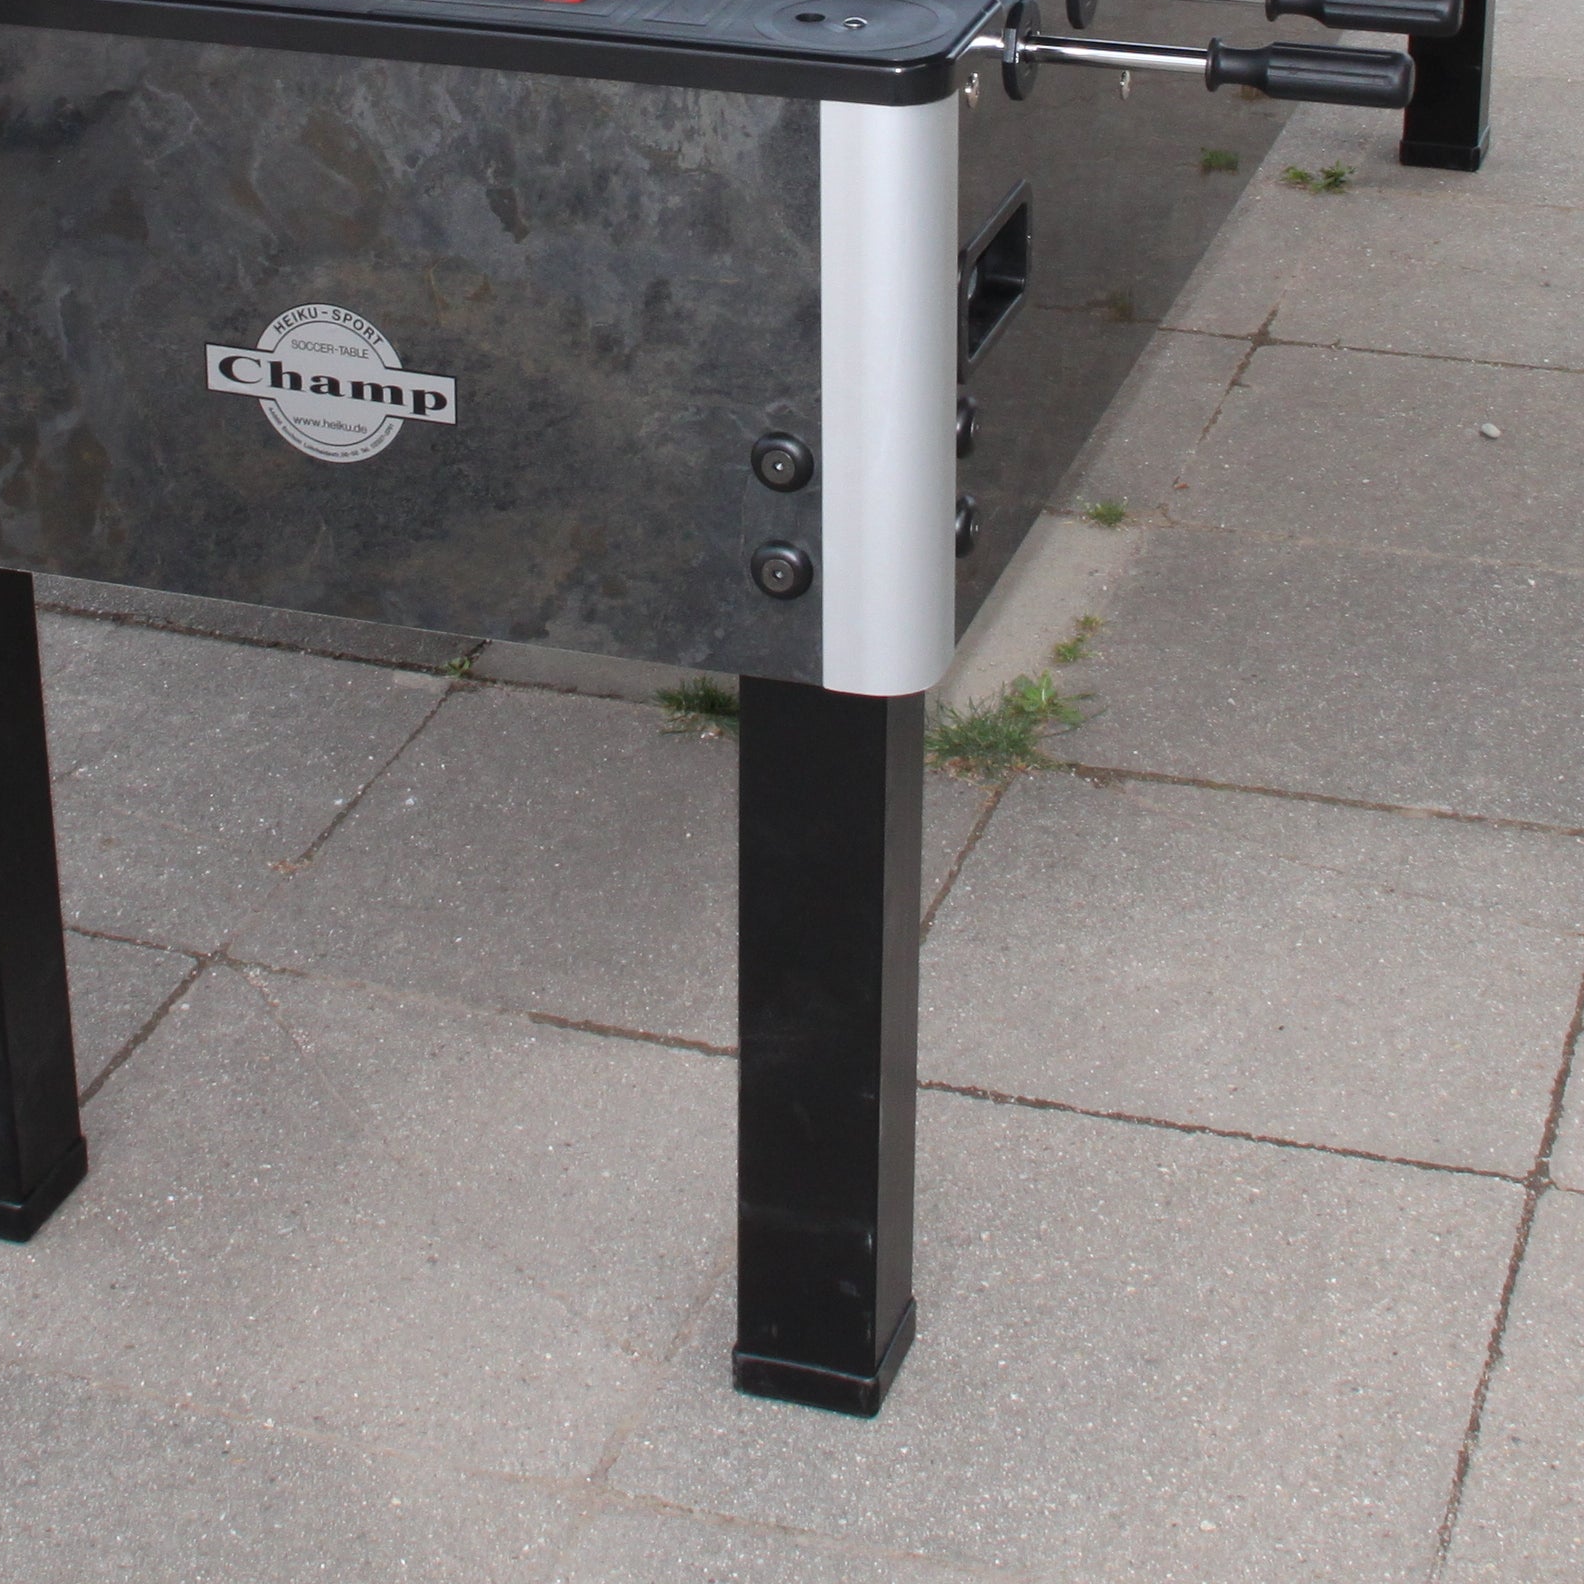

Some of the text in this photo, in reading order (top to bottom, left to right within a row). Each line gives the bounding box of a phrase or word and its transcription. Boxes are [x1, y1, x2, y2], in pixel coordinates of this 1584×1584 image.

[290, 338, 370, 360] SOCCER-TABLE
[217, 354, 448, 416] Champ
[292, 416, 368, 435] www.heiku.de
